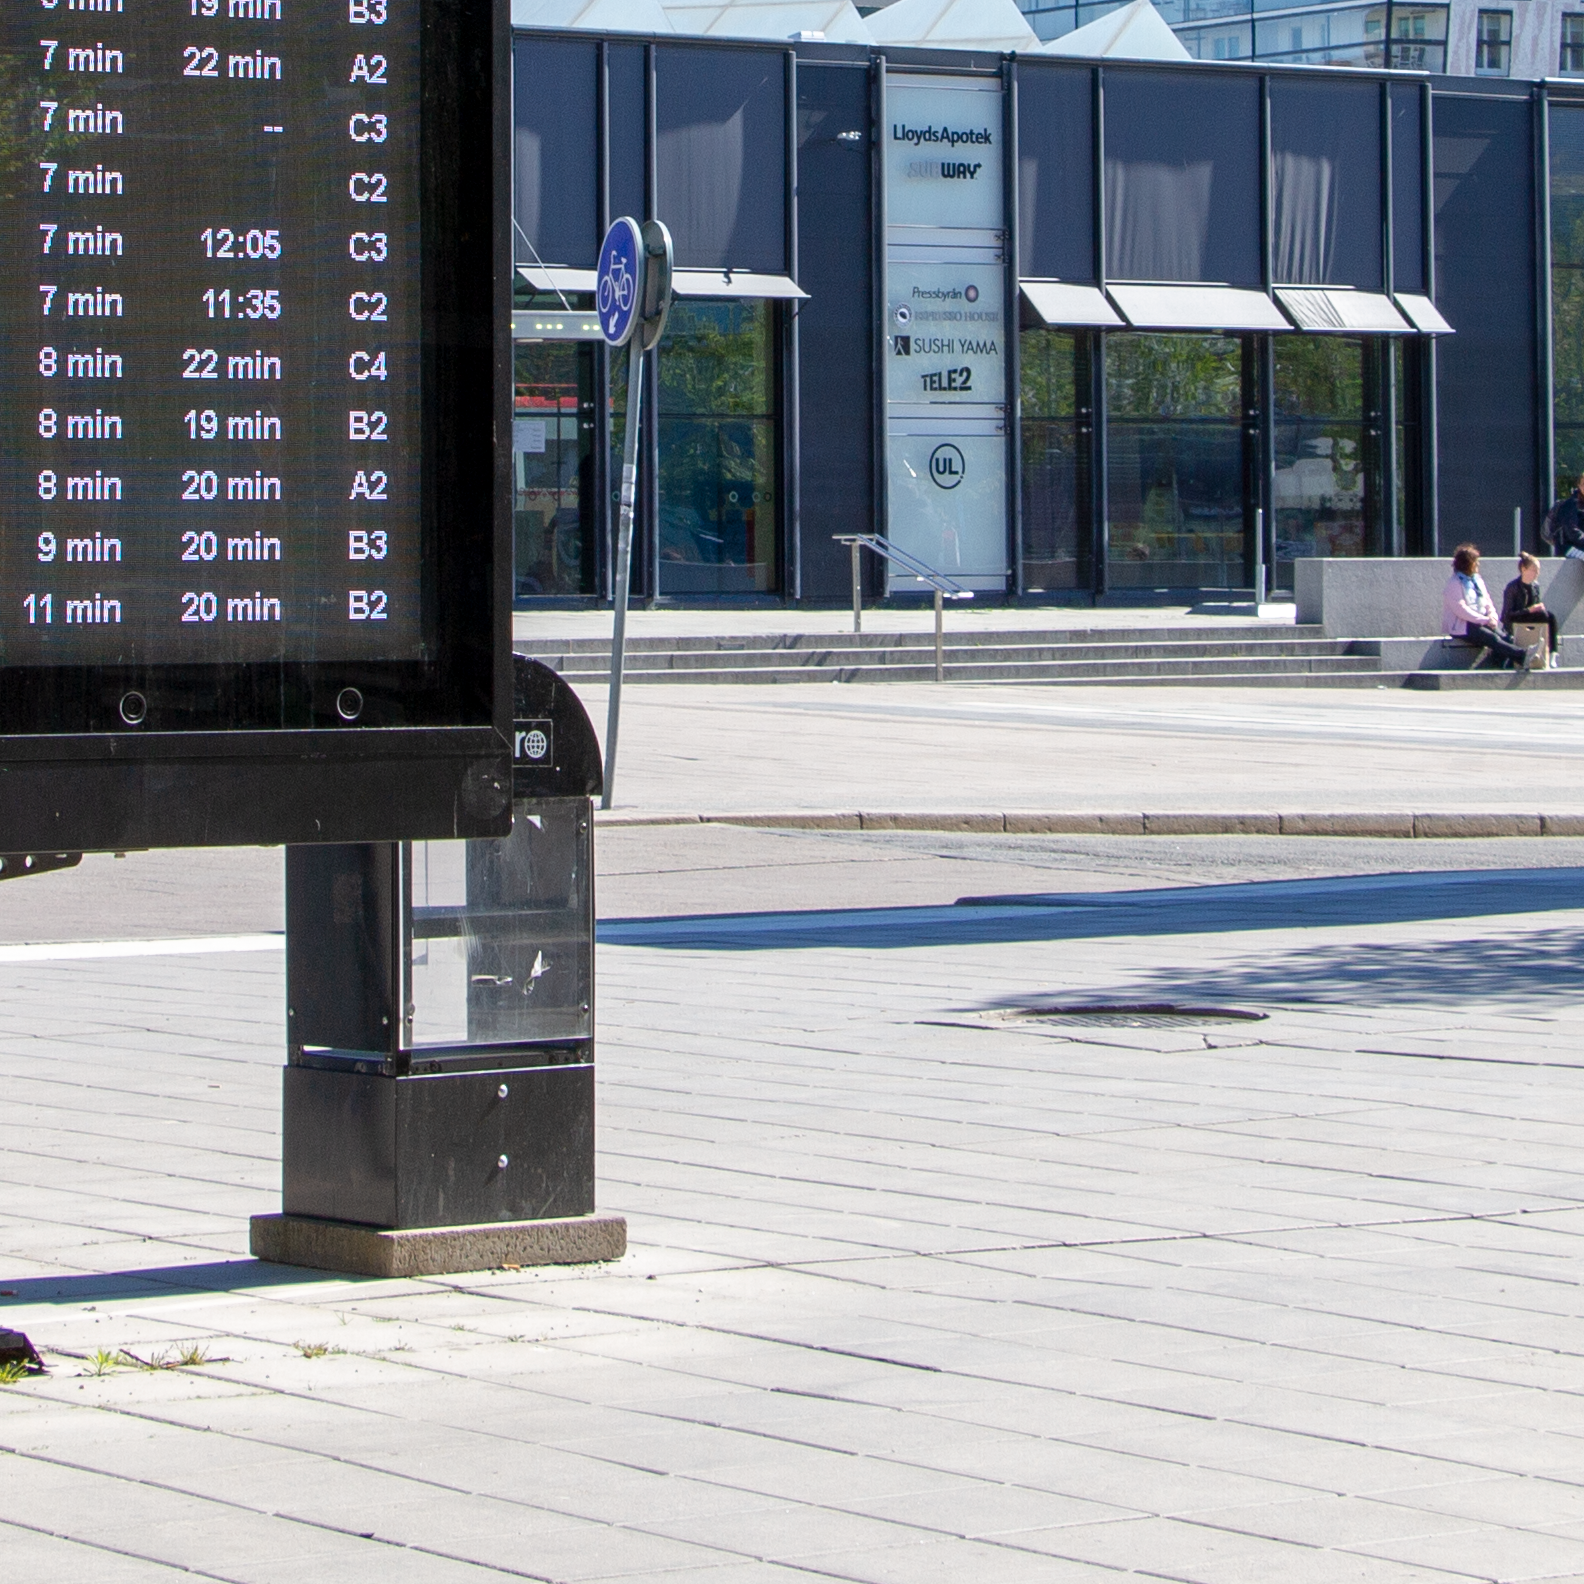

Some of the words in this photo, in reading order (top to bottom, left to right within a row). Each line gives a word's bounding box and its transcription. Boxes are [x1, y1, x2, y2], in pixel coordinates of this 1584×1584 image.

[40, 40, 58, 70] 7
[68, 43, 124, 73] min
[182, 46, 219, 77] 22
[227, 49, 282, 80] min
[349, 54, 387, 83] A2
[348, 113, 388, 143] C3
[893, 124, 992, 148] LloydsApotek
[348, 172, 388, 203] C2
[200, 228, 281, 258] 12:05
[349, 232, 388, 261] C3
[201, 289, 281, 319] 11:35
[349, 291, 388, 321] C2
[912, 286, 962, 302] Pressbyrån
[914, 338, 955, 354] SUSHI
[959, 339, 998, 355] YAMA
[182, 349, 219, 379] 22
[227, 350, 281, 380] min
[349, 351, 387, 380] C4
[921, 366, 972, 391] TELE2
[184, 410, 218, 440] 19
[227, 410, 281, 440] min
[349, 410, 388, 440] B2
[935, 457, 959, 475] UL
[181, 470, 218, 500] 20
[227, 471, 281, 500] min
[349, 470, 388, 500] A2
[38, 531, 56, 561] 9
[66, 532, 122, 562] min
[181, 531, 217, 561] 20
[227, 531, 281, 561] min
[348, 530, 388, 560] B3
[23, 593, 53, 624] 11
[65, 593, 121, 623] min
[181, 592, 217, 622] 20
[227, 592, 281, 621] min
[348, 590, 388, 620] B2
